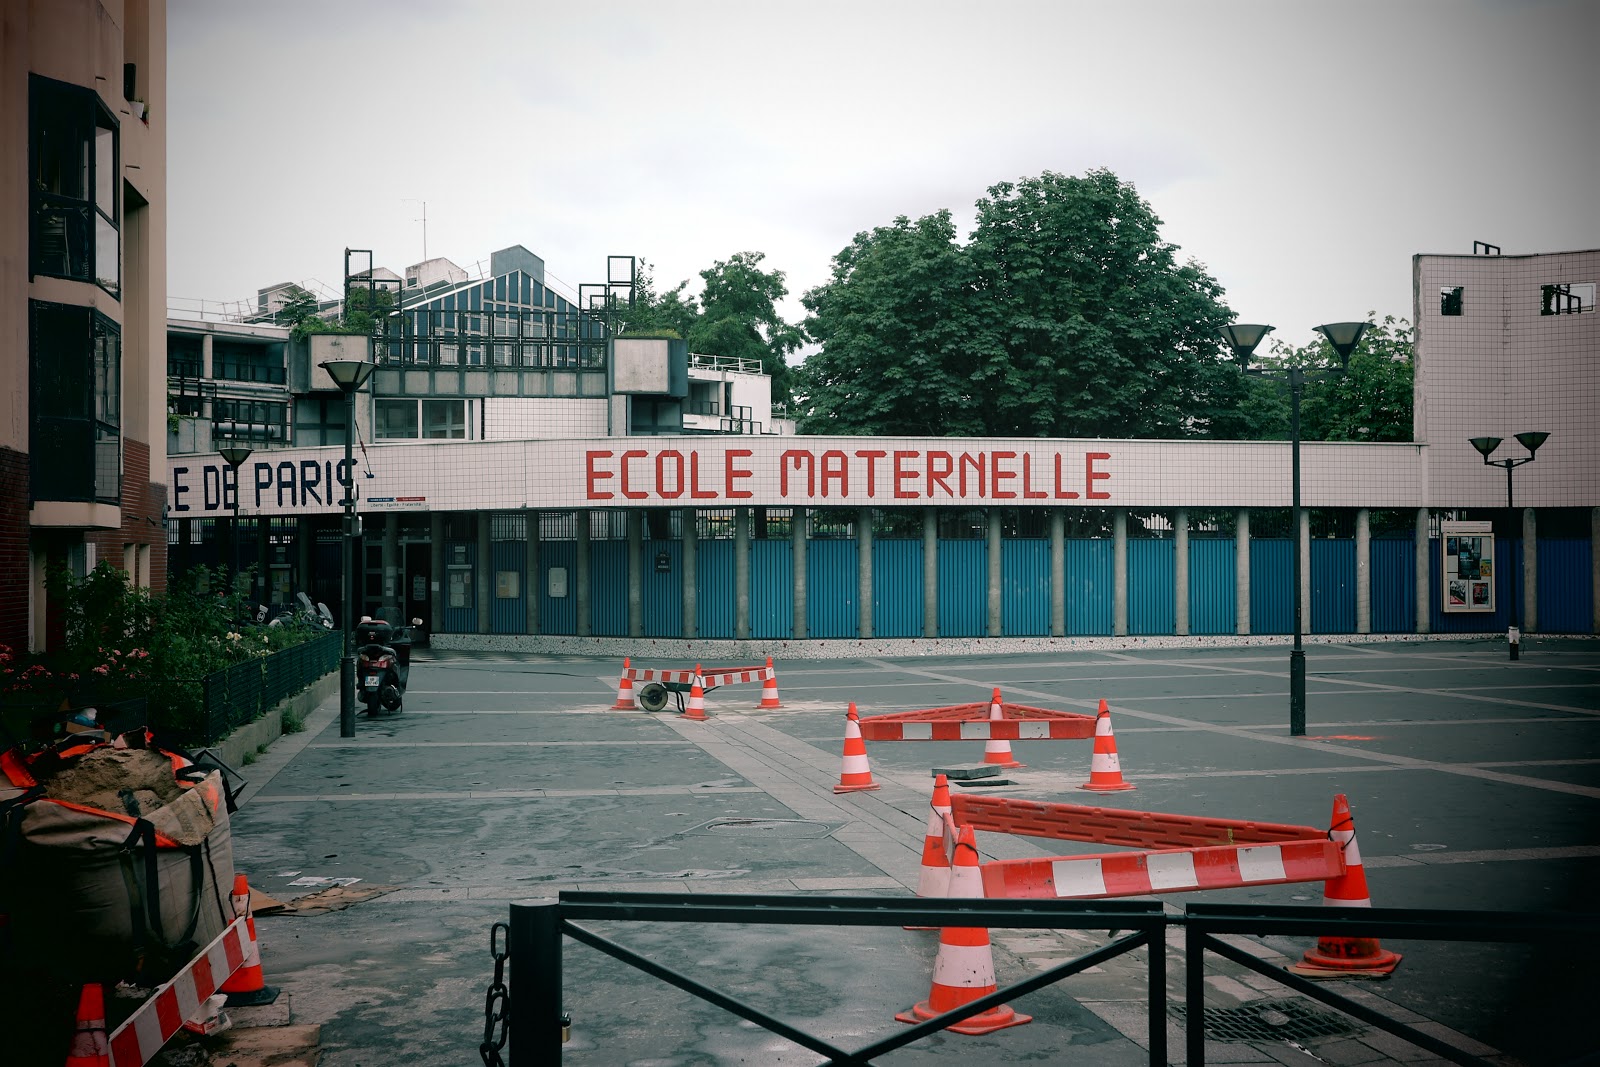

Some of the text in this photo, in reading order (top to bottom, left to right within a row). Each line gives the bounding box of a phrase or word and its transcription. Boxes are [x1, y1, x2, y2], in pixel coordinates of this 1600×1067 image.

[168, 467, 190, 511] E
[255, 459, 358, 507] PARIS
[587, 449, 1109, 499] ECOLE MATERNELLE
